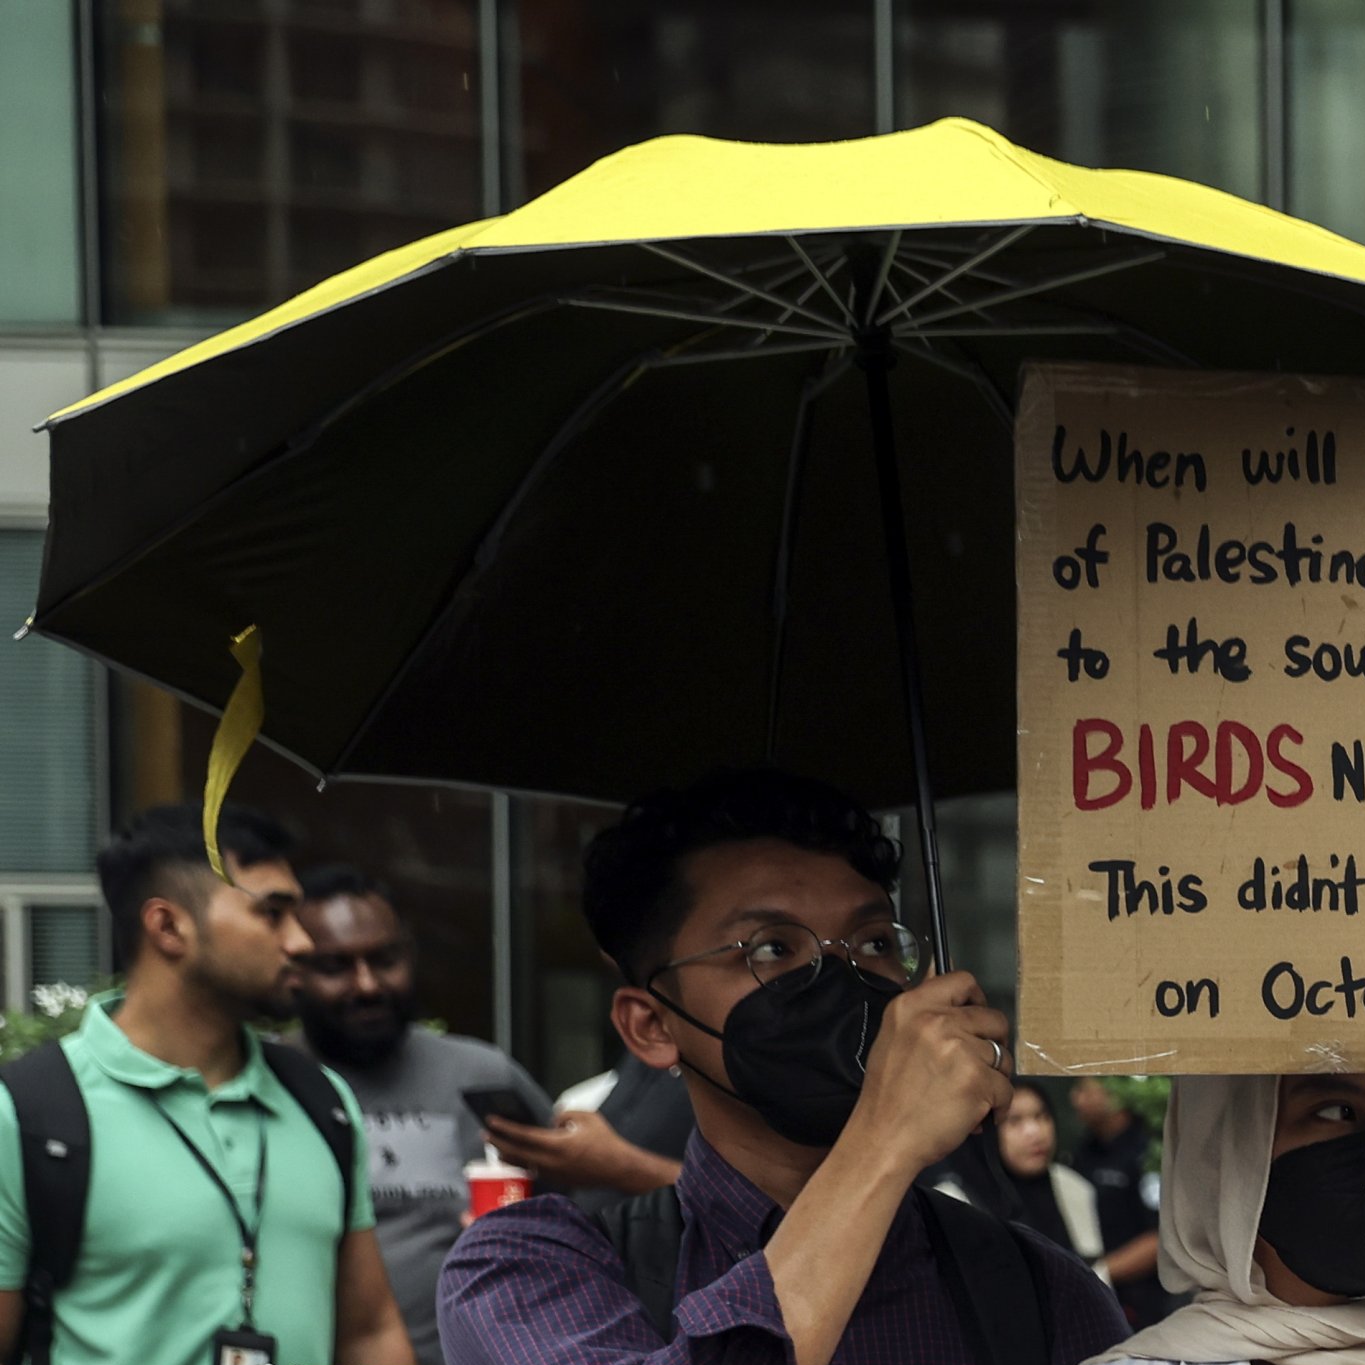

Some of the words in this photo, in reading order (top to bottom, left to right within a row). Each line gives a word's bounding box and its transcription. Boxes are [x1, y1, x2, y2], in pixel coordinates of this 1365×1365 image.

[1052, 424, 1207, 492] When
[1242, 426, 1337, 485] will
[1053, 524, 1110, 590] of
[1058, 630, 1110, 682] to
[1153, 617, 1251, 685] the
[1071, 718, 1314, 811] BIRDS
[1089, 860, 1207, 920] This
[1155, 977, 1219, 1018] on
